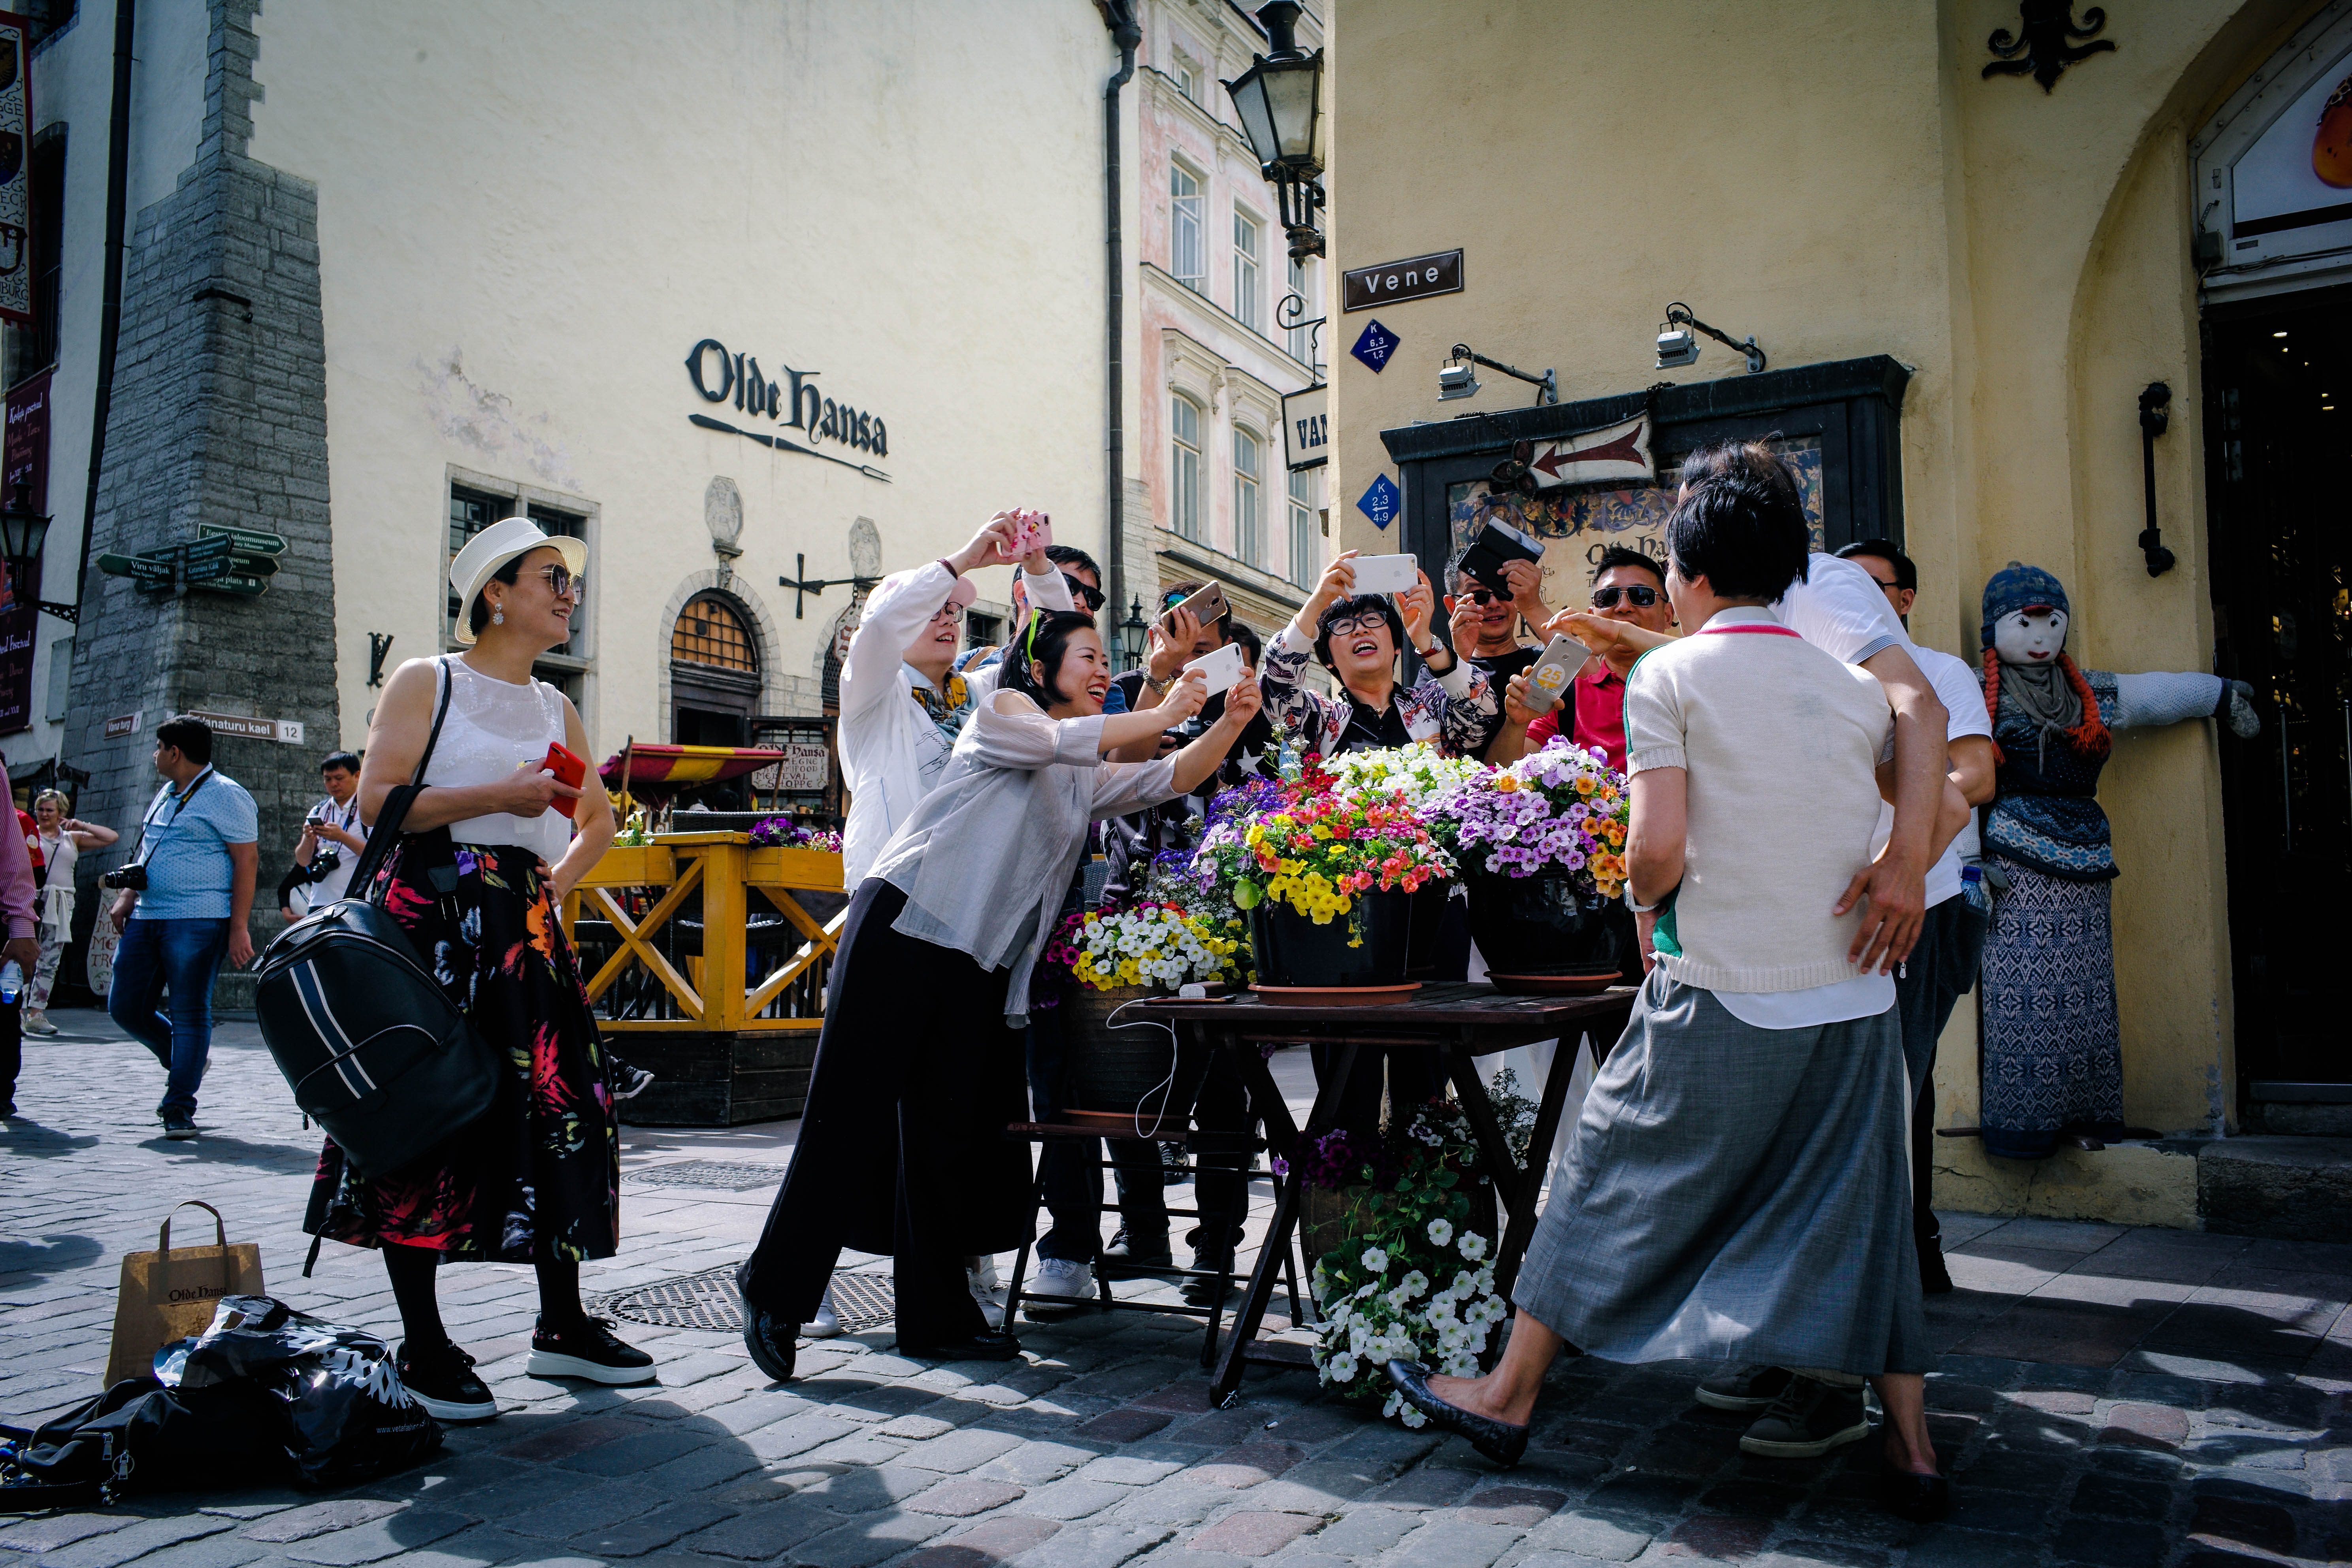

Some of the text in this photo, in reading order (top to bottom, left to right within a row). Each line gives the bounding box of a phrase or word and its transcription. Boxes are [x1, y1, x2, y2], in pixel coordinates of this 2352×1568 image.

[1365, 267, 1439, 294] Vene
[0, 281, 29, 301] BURG
[1370, 324, 1378, 334] K
[1370, 337, 1384, 347] 6,3
[1373, 350, 1384, 360] 1,2
[685, 338, 782, 420] Olde
[1378, 483, 1385, 493] K
[1372, 495, 1389, 506] 2,3
[1373, 512, 1389, 522] 4,9
[131, 561, 170, 575] Viru väljak
[226, 576, 242, 585] plats
[1540, 667, 1562, 681] 25
[108, 720, 131, 732] Vana turg
[249, 722, 270, 735] kael
[284, 726, 298, 738] 12
[169, 1289, 196, 1301] Olde
